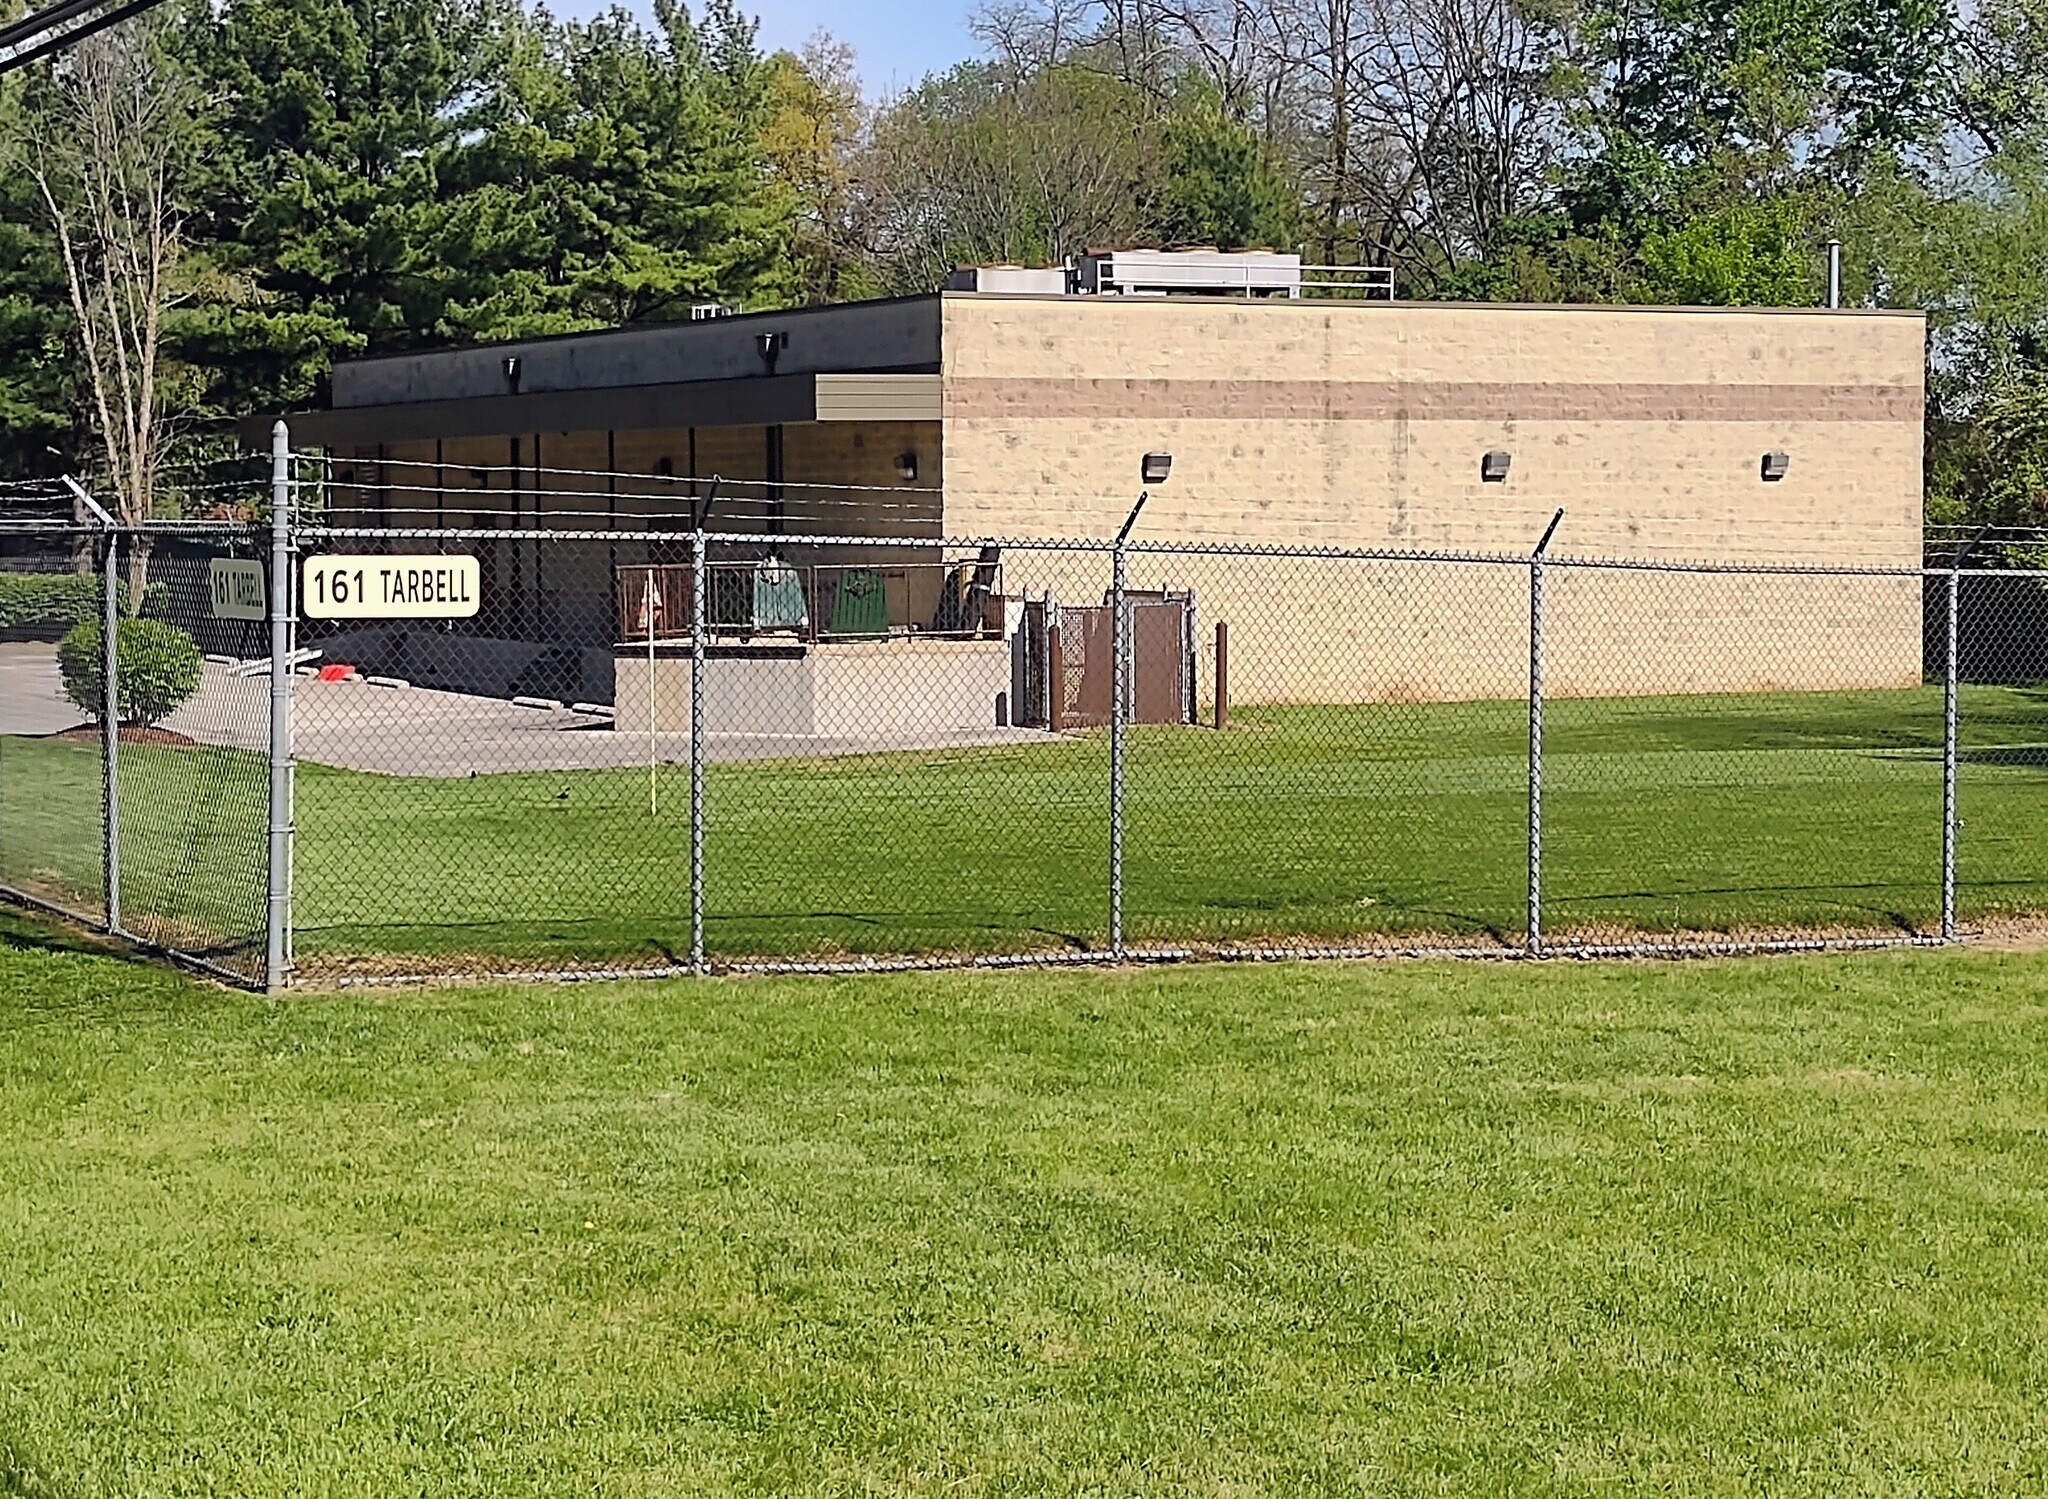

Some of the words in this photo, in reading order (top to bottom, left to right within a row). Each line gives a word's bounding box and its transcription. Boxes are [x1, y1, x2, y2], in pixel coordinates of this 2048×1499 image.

[213, 570, 230, 604] 161
[314, 569, 364, 603] 161
[380, 569, 470, 603] TARBELL
